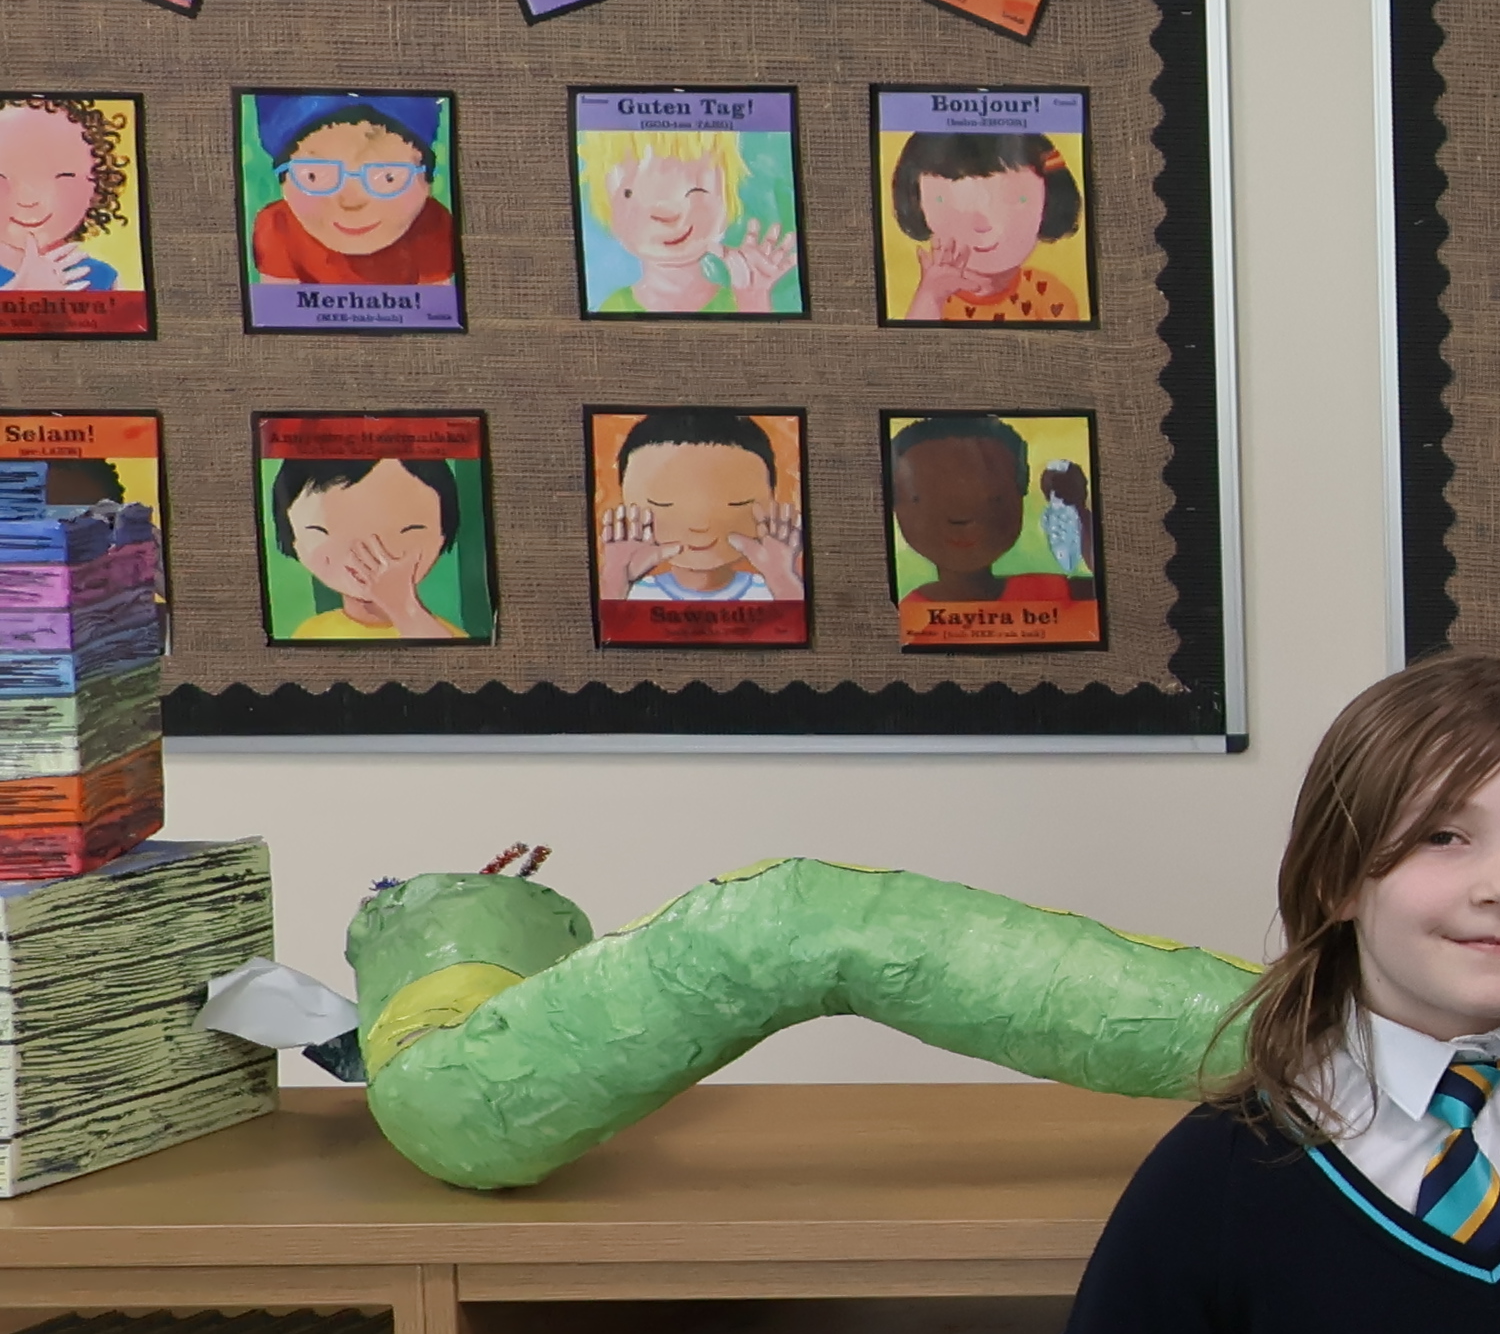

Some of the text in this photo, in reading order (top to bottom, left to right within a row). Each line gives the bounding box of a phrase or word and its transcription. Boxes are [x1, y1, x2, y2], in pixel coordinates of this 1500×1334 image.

[617, 98, 753, 119] Guten Tag!
[932, 95, 1040, 116] Bonjour!
[297, 291, 421, 310] Merhaba!
[5, 425, 94, 443] Selam!
[928, 608, 1058, 629] Kayira be!
